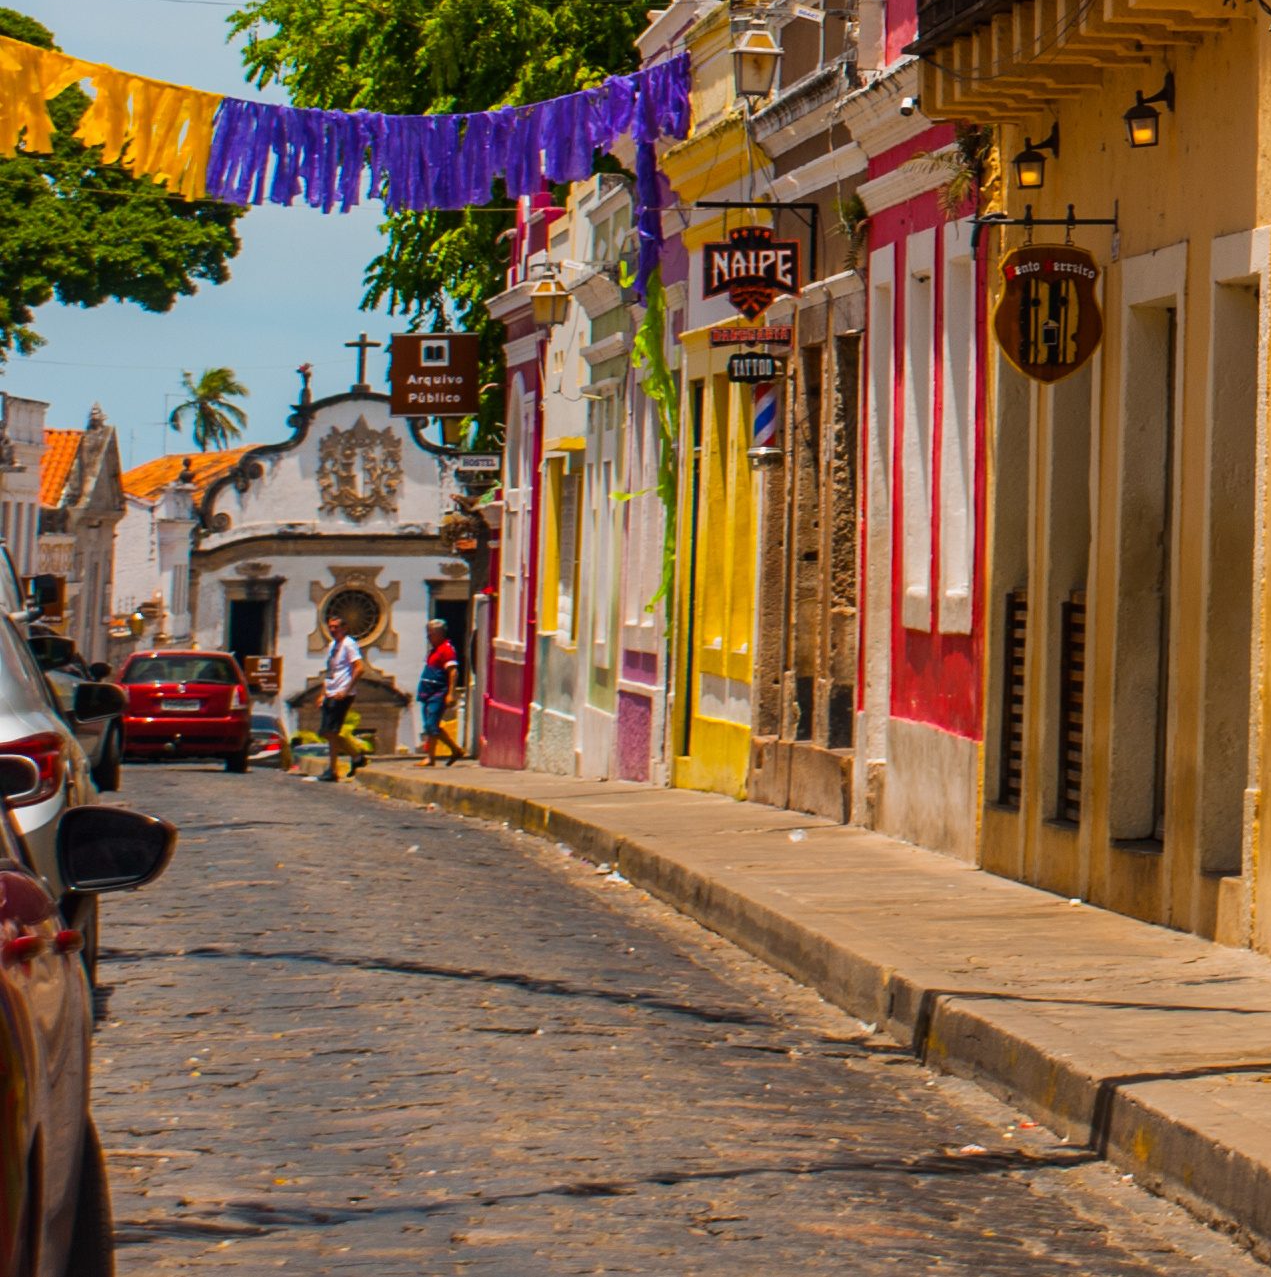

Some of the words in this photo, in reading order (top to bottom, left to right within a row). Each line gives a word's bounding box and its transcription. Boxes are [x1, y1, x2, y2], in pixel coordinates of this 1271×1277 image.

[712, 250, 793, 287] NAIPE
[732, 358, 773, 377] TATTOO
[406, 374, 464, 387] Arquivo
[408, 392, 462, 404] Público
[462, 458, 496, 467] HOSTEL
